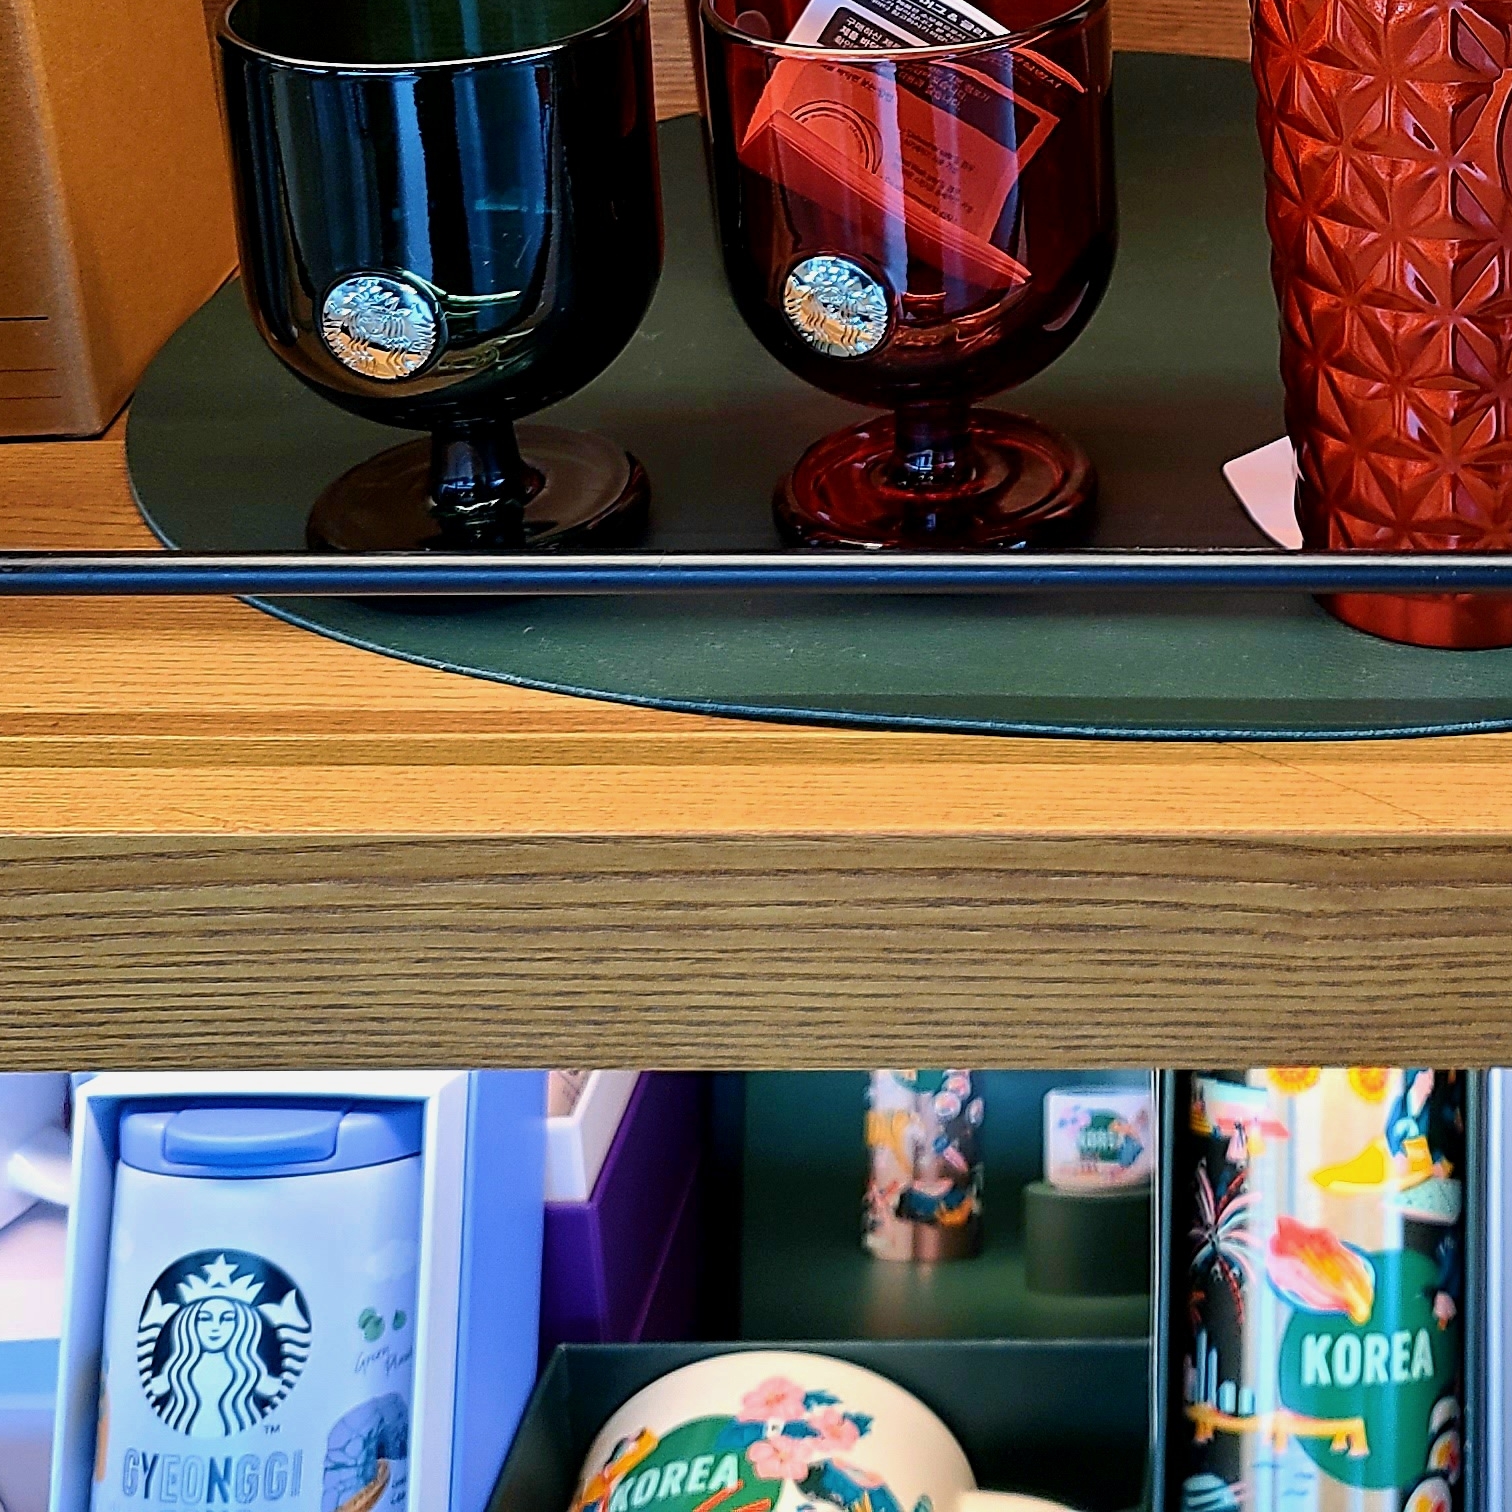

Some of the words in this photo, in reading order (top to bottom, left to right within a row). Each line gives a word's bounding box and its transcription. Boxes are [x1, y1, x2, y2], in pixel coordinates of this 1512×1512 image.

[1301, 1328, 1435, 1387] KOREA
[122, 1447, 303, 1505] GYEONGGI
[609, 1453, 739, 1512] KOREA
